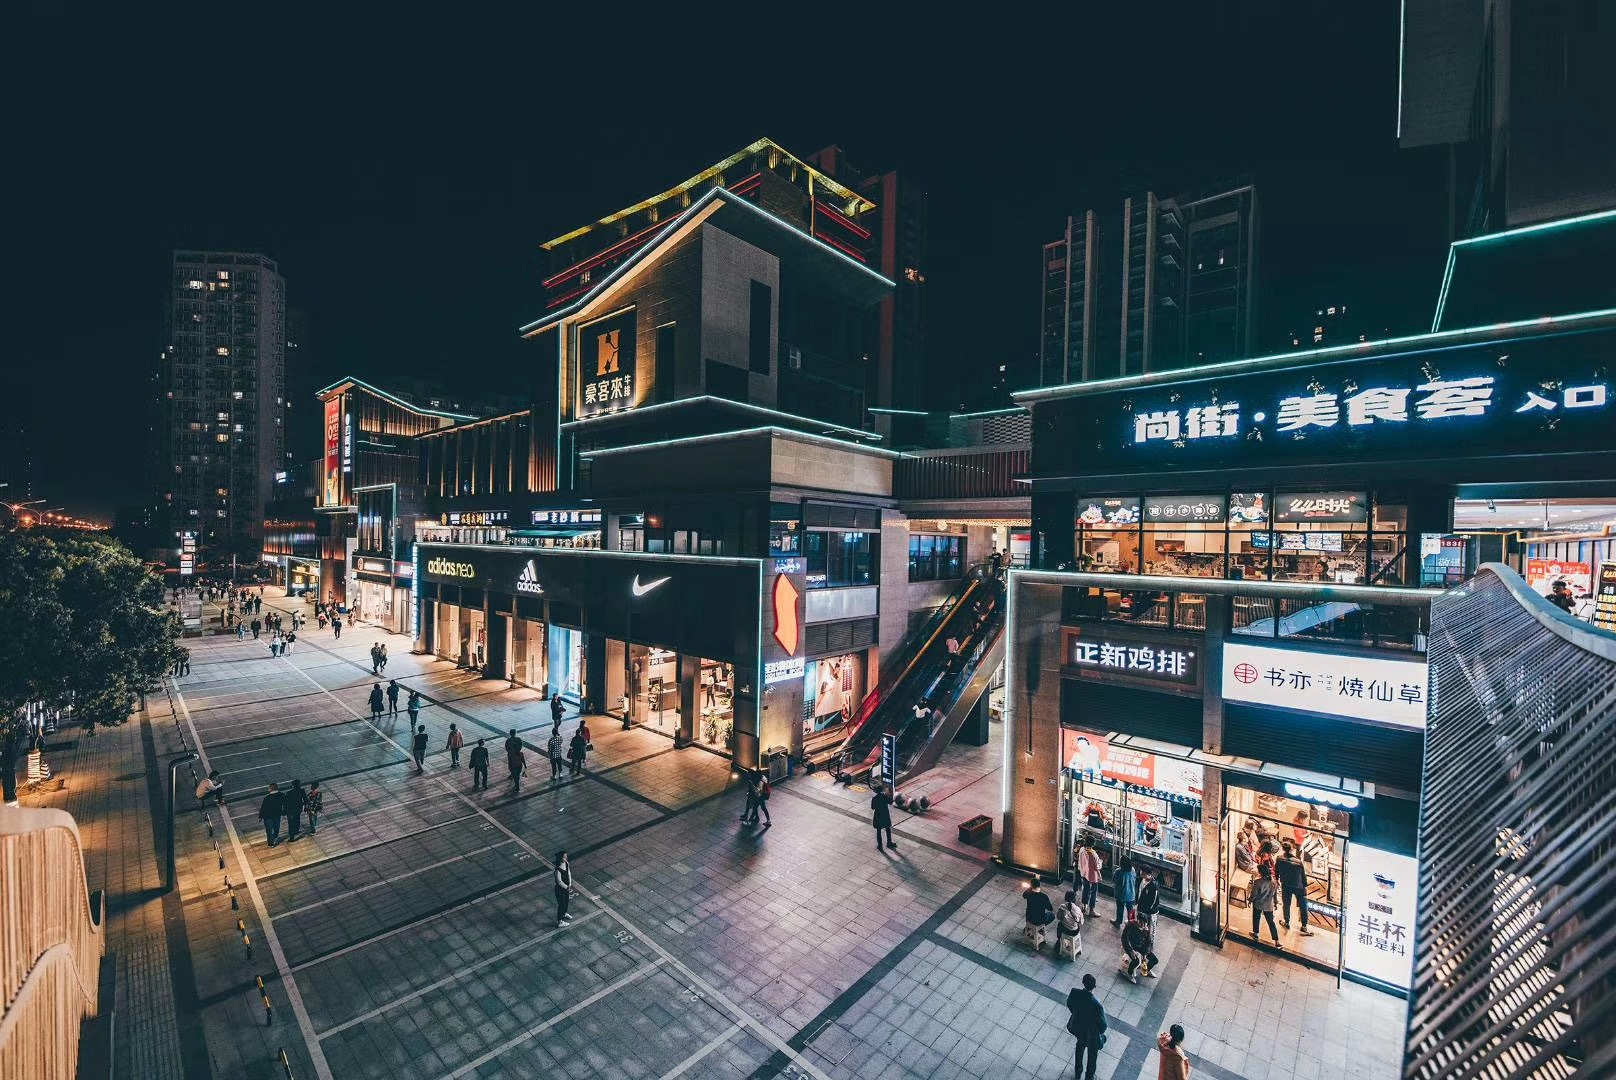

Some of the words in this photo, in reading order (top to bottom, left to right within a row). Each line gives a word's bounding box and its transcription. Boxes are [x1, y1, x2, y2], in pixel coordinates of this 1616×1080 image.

[585, 377, 623, 405] 豪客來
[1516, 384, 1607, 414] 入口
[517, 580, 541, 593] adidas
[1076, 642, 1186, 676] 正新鸡排
[1263, 667, 1312, 690] 书亦
[1358, 914, 1406, 942] 半杯
[1358, 932, 1405, 957] 都是料
